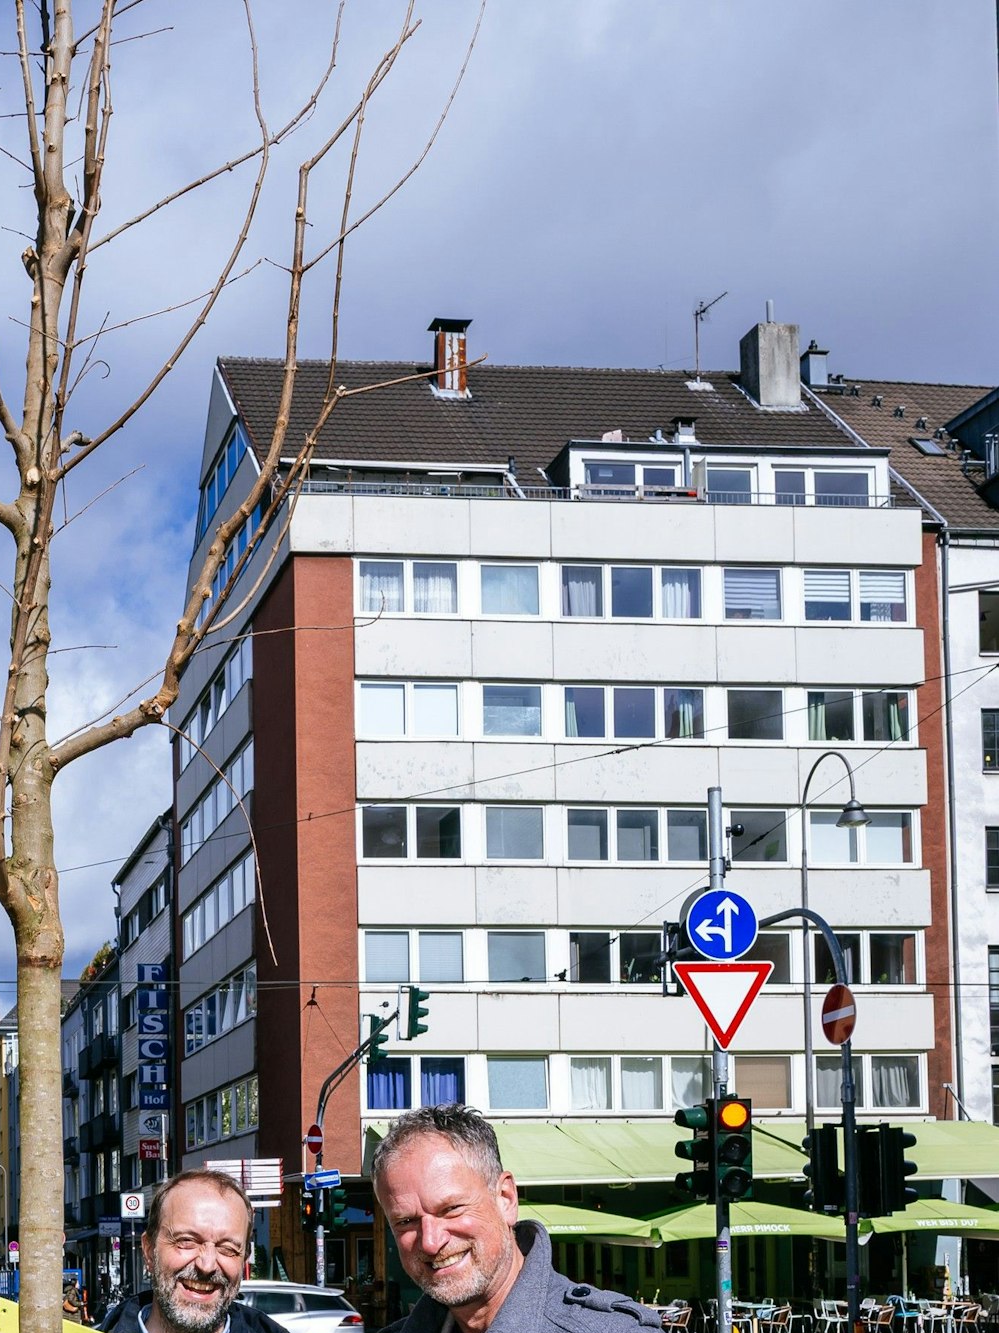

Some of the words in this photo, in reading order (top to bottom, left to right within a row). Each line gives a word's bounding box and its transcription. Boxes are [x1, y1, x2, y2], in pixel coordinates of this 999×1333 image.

[140, 963, 166, 1084] FISCH
[143, 1093, 165, 1105] Hof
[141, 1142, 161, 1151] Sus
[128, 1199, 137, 1207] 30
[917, 1219, 938, 1227] WER
[960, 1218, 979, 1227] DU?
[730, 1225, 753, 1233] HERR
[754, 1224, 791, 1233] PIMOCK
